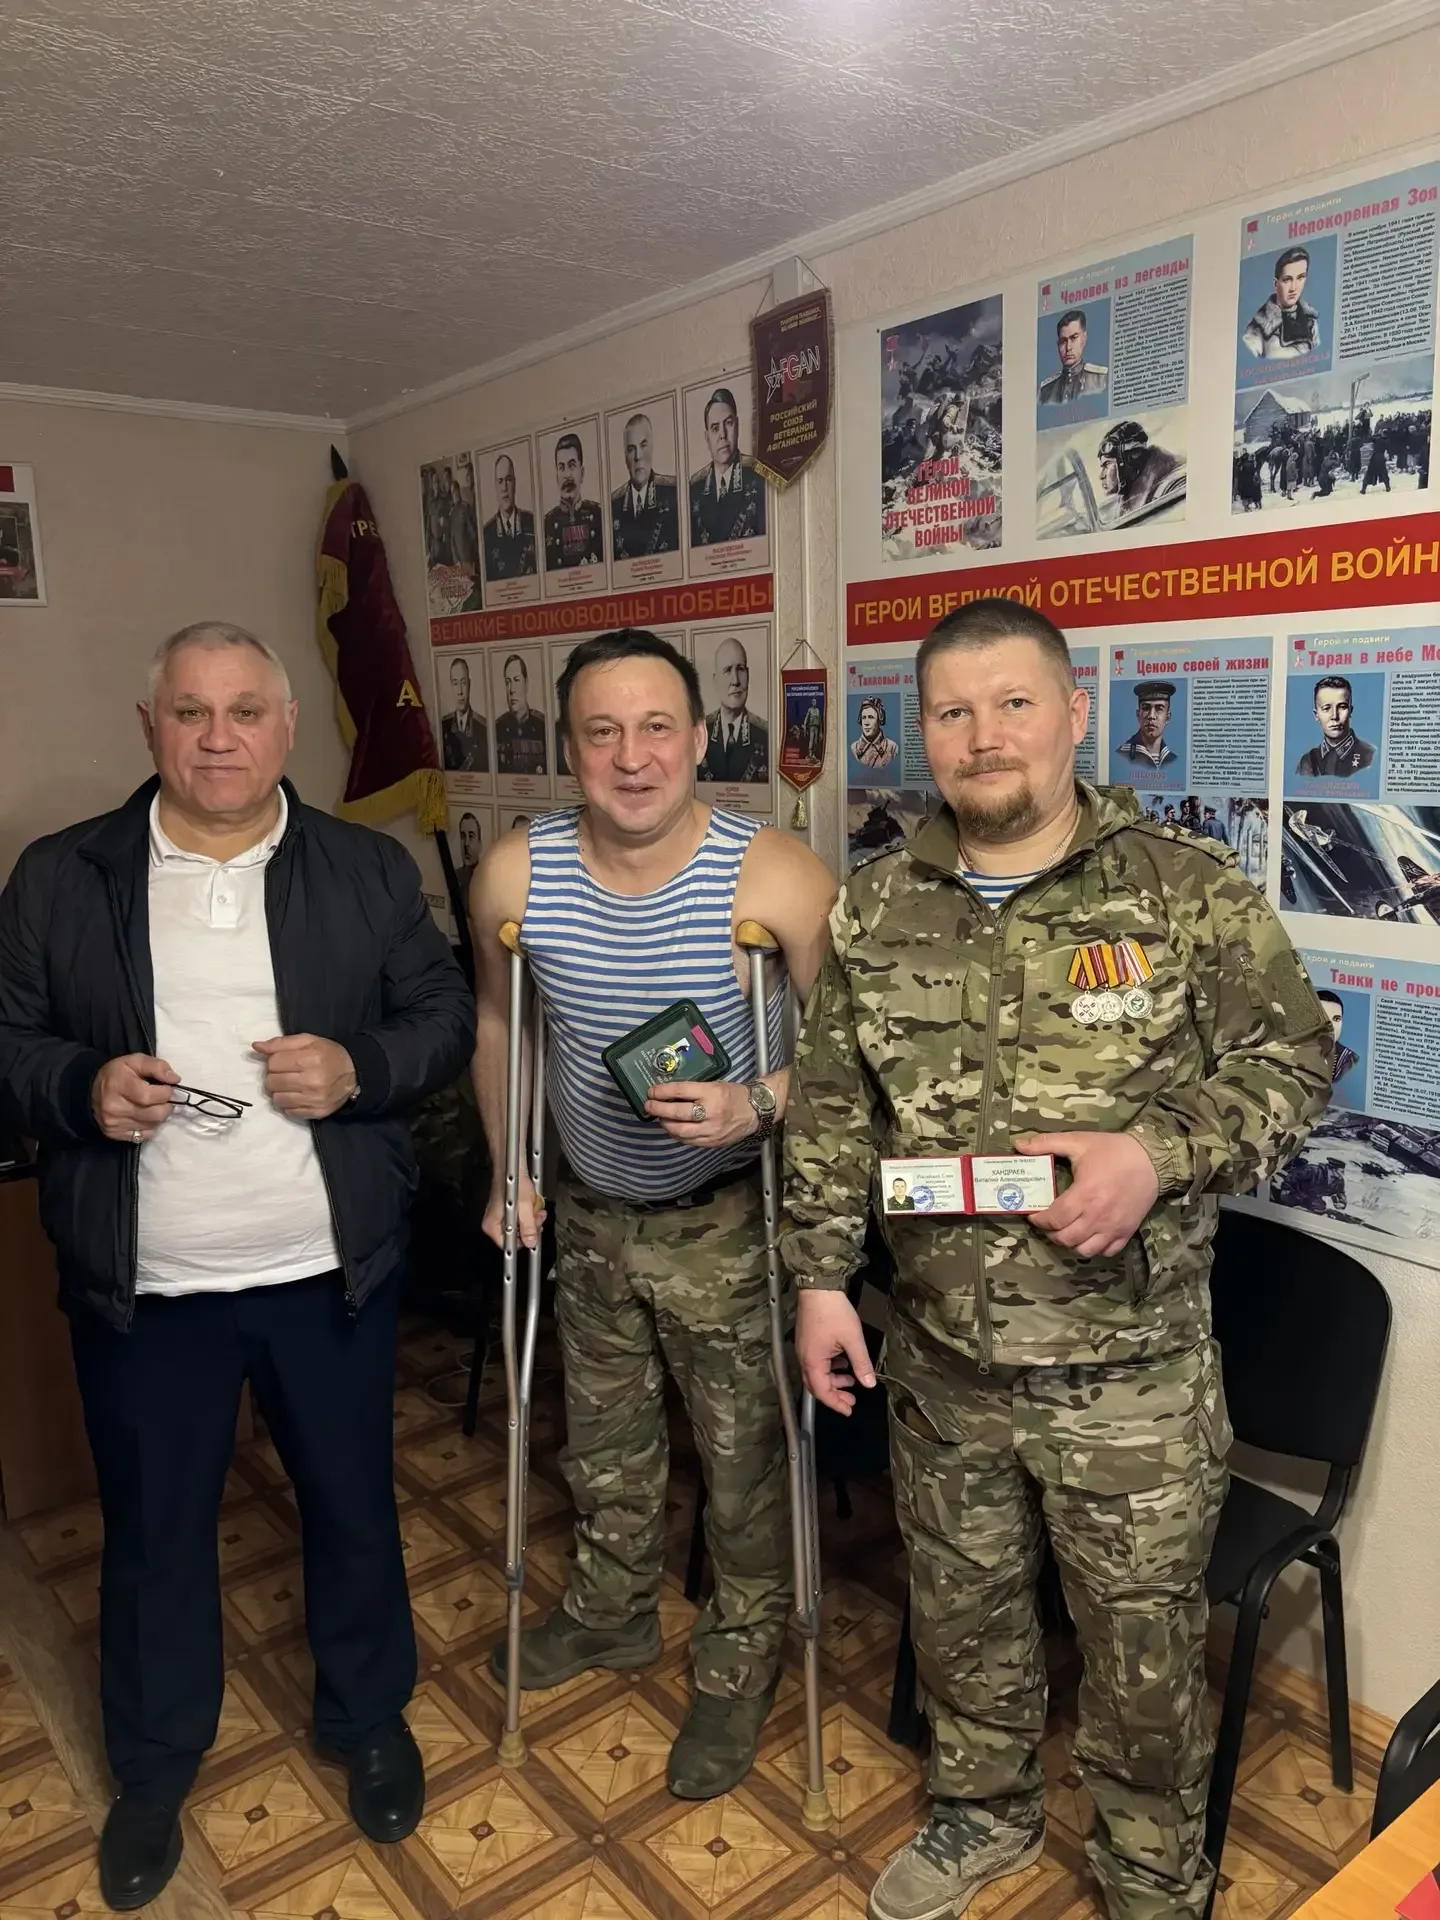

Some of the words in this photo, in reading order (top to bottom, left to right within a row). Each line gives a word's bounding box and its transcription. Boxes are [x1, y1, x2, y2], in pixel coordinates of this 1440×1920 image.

[1288, 196, 1399, 239] Непокоренная
[1408, 186, 1439, 206] Зоя
[1060, 281, 1110, 304] Человек
[1114, 276, 1128, 290] из
[1134, 258, 1189, 284] легенды
[770, 399, 818, 423] РОССИЙСКИЙ
[783, 415, 803, 428] СОЮЗ
[766, 430, 818, 452] АФГАНИСТАНА
[773, 421, 814, 441] ВЕТЕРАНОВ
[917, 456, 959, 482] ГЕРОИ
[907, 475, 971, 505] ВЕЛИКОЙ
[885, 490, 995, 529] ОТЕЧЕСТВЕННОЙ
[914, 523, 963, 548] ВОЙНЫ
[854, 597, 921, 627] ГЕРОИ
[1050, 547, 1318, 607] ОТЕЧЕСТВЕННОЙ
[1331, 536, 1440, 583] ВОЙН
[431, 615, 506, 642] ВЕЛИКИЕ
[512, 597, 655, 634] ПОЛКОВОДЦЫ
[663, 581, 773, 616] ПОБЕДЫ
[1136, 659, 1177, 676] Ценою
[1183, 657, 1220, 672] своей
[1225, 657, 1269, 671] жизни
[1308, 650, 1352, 668] Таран
[1360, 652, 1369, 664] в
[1376, 644, 1413, 664] небе
[858, 672, 900, 687] Танковый
[1339, 958, 1375, 969] подвиги
[1329, 967, 1374, 988] Танки
[1381, 979, 1398, 991] не
